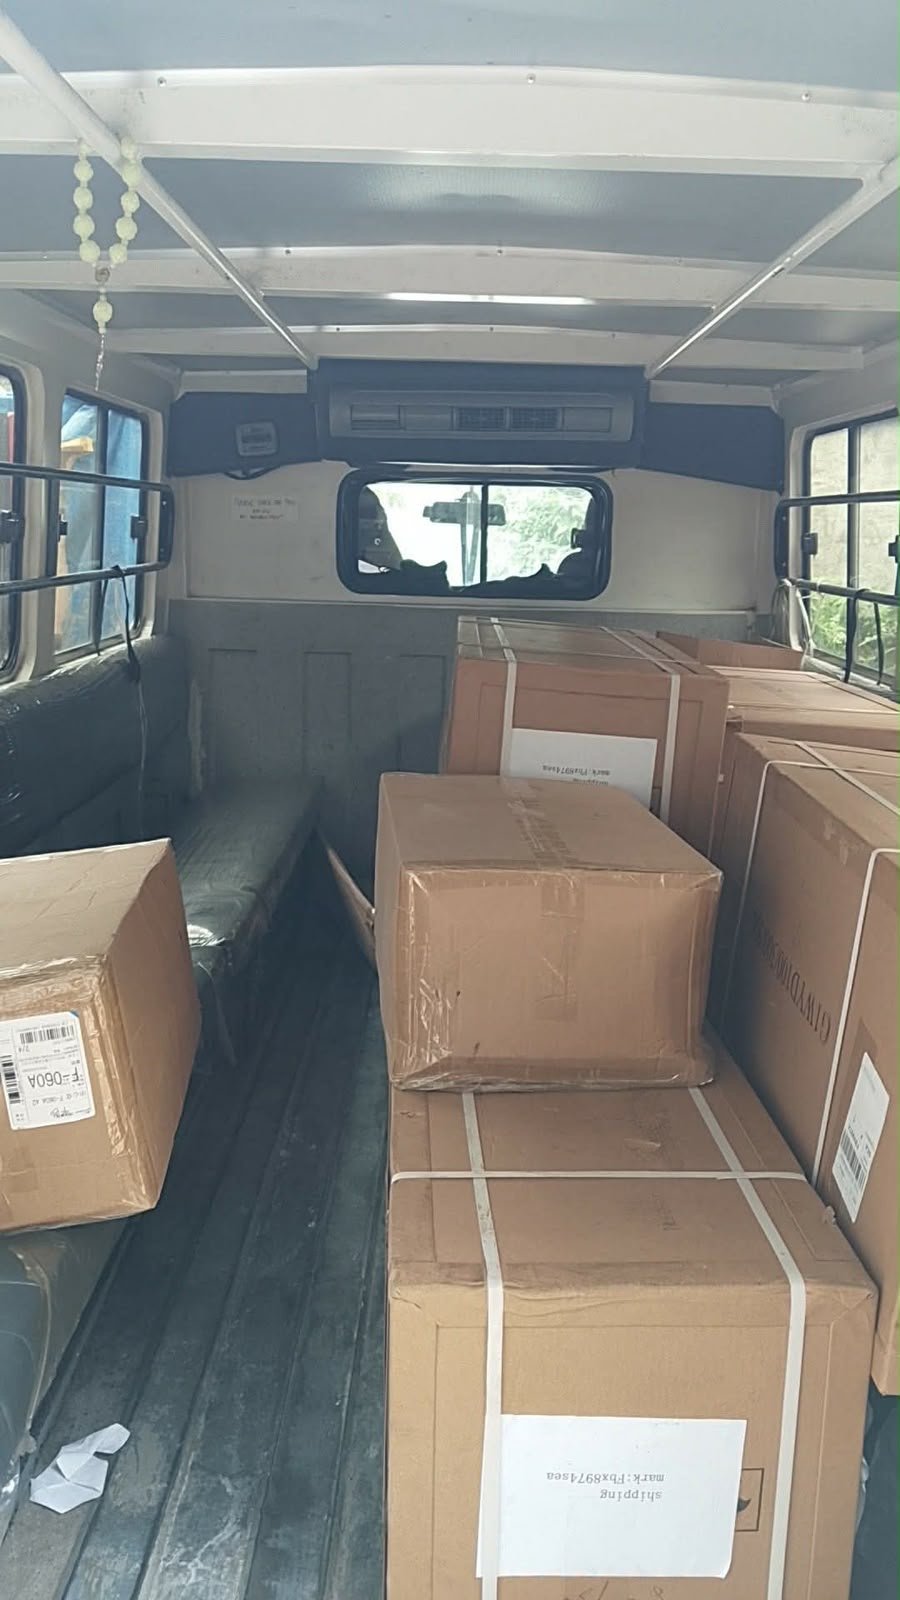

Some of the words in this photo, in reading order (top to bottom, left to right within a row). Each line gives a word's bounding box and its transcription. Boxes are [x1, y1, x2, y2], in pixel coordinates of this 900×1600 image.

[28, 1067, 79, 1088] F-060A
[546, 1472, 665, 1485] mark:Fbx8974sea
[600, 1489, 662, 1502] shipping
